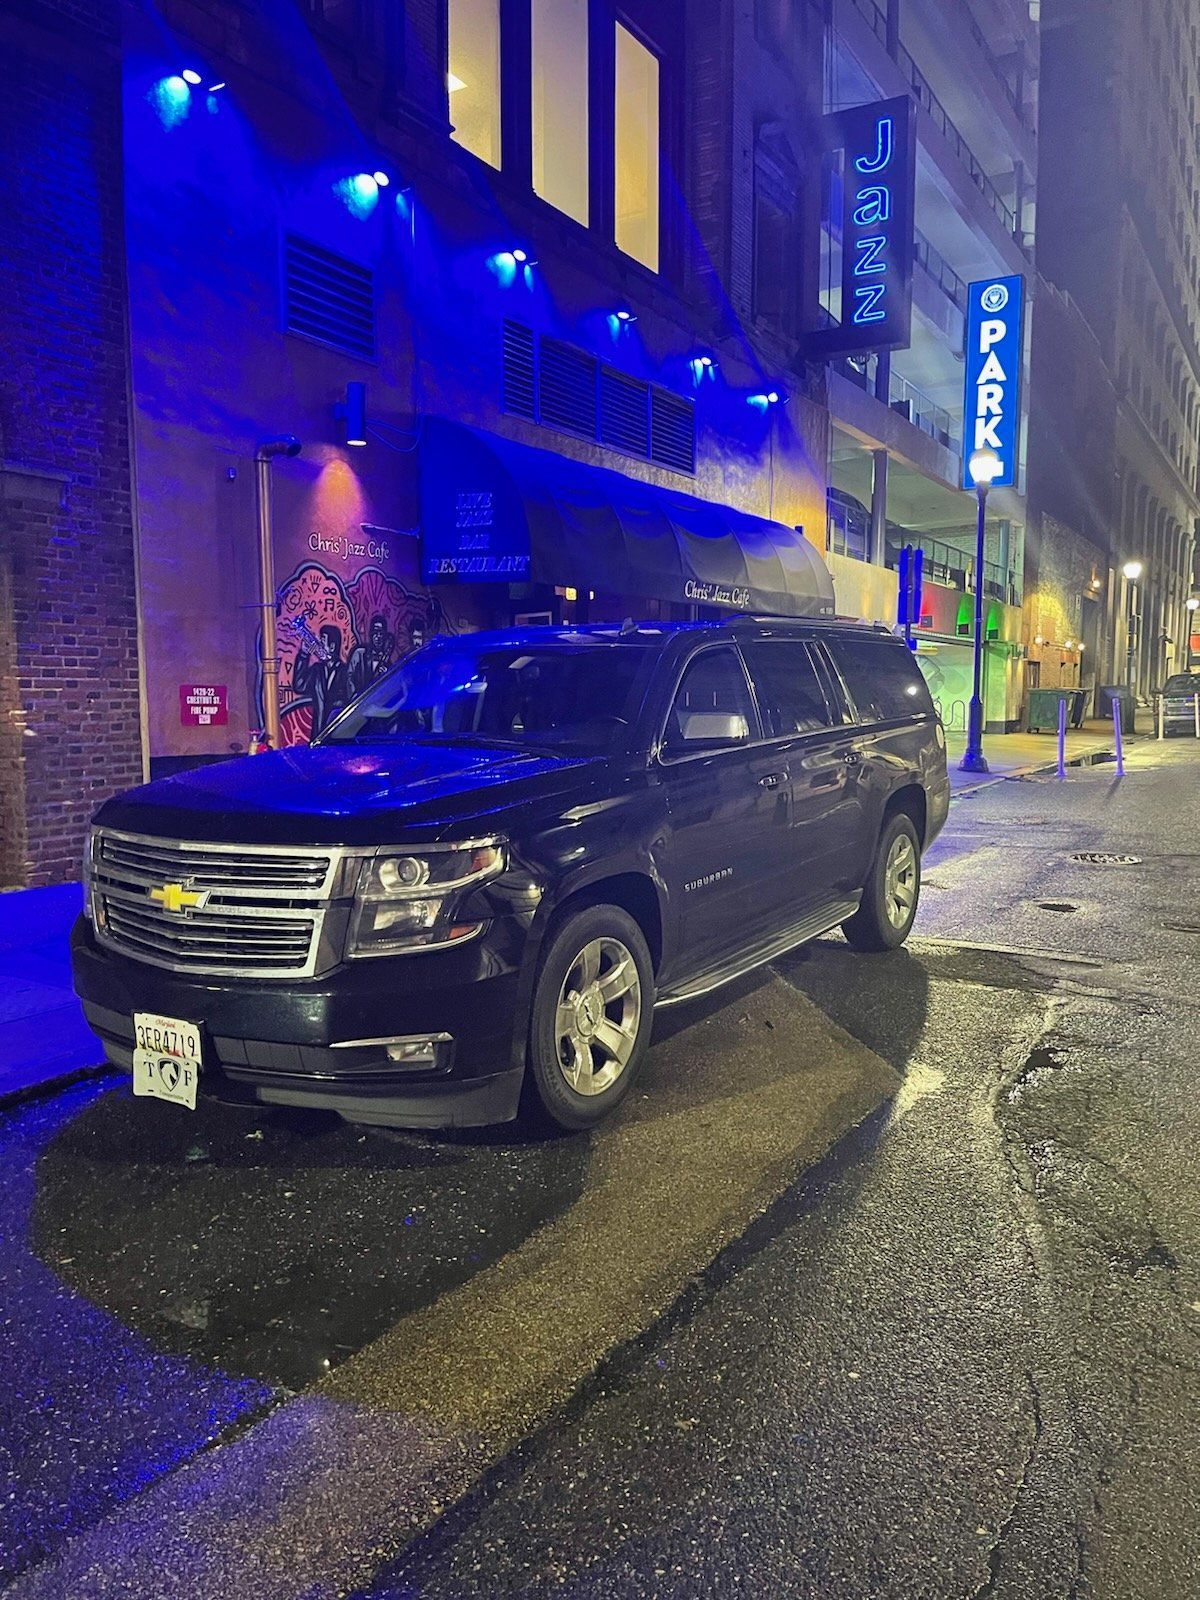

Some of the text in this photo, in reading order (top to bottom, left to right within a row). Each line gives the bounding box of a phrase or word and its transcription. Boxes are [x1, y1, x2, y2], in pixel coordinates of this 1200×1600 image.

[853, 119, 891, 324] Jazz
[974, 318, 1008, 451] PARK
[456, 492, 493, 509] LIVE
[455, 510, 493, 528] JAZZ
[308, 532, 390, 564] Chris' Jazz Cafe
[459, 533, 490, 550] BAR
[428, 556, 530, 574] RESTAURANT
[684, 579, 750, 608] Chris' Jazz Cafe
[186, 696, 212, 704] CHESTNUT
[190, 706, 218, 715] FIRE PUMP
[684, 867, 733, 892] SUBURBAN
[137, 1025, 196, 1059] 3ER4719
[143, 1061, 193, 1087] T F
